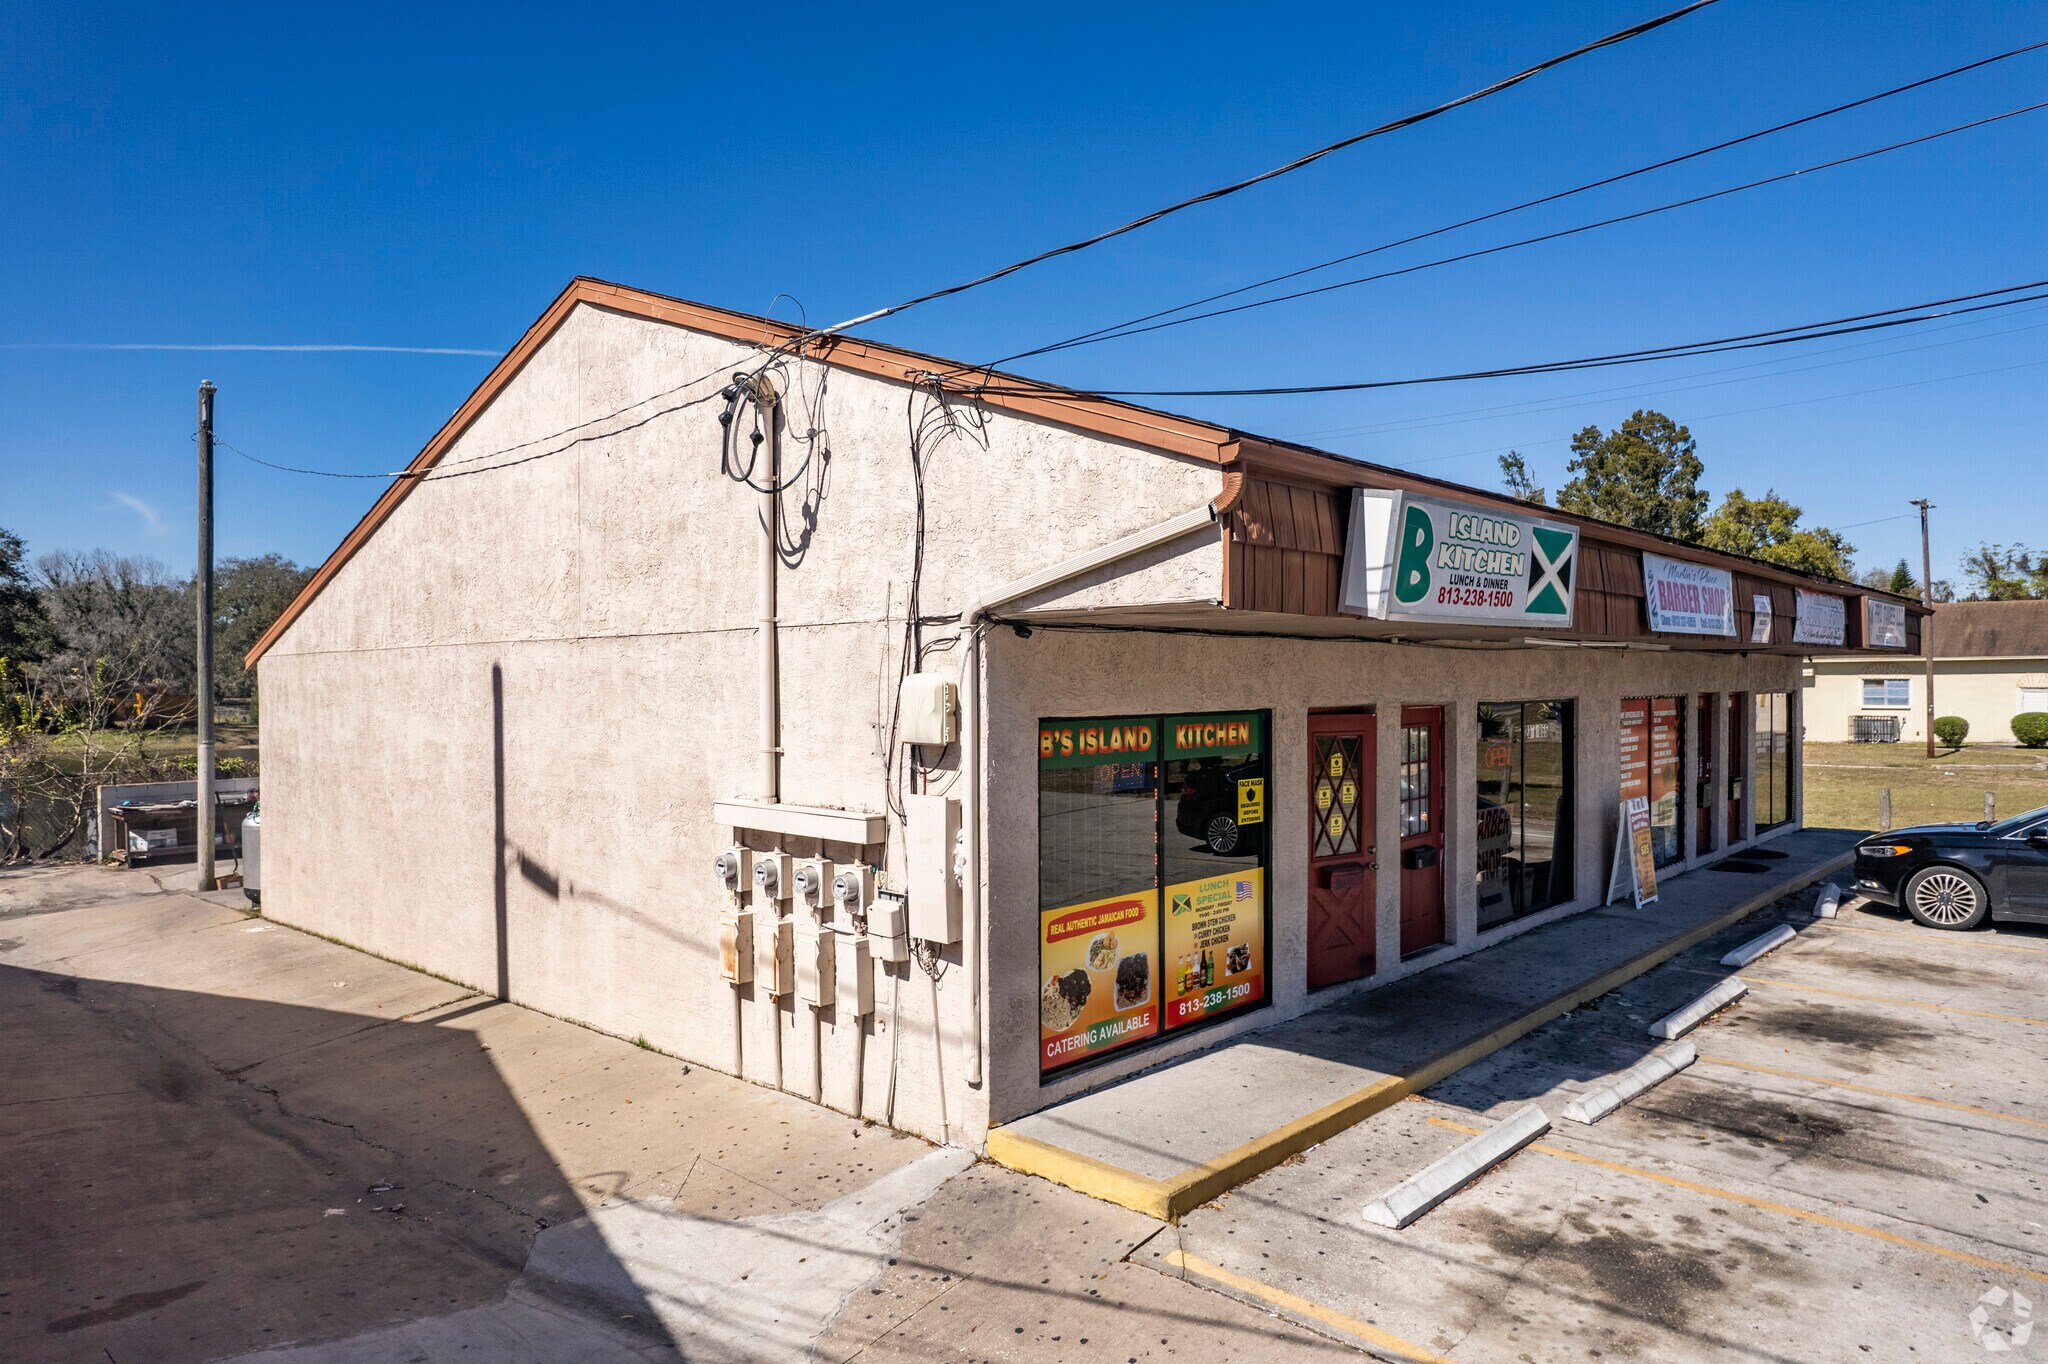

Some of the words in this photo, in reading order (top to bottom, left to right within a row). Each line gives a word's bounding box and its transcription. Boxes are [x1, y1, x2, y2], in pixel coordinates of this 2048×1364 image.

[1449, 512, 1521, 548] ISLAND
[1395, 504, 1434, 603] B
[1437, 542, 1526, 577] KITCHEN
[1450, 573, 1475, 587] LUNCH
[1476, 576, 1482, 588] &
[1483, 577, 1509, 590] DINNER
[1664, 561, 1696, 581] Martin's
[1437, 586, 1513, 608] 813-238-1500
[1658, 579, 1701, 613] BARBER
[1702, 585, 1726, 616] SHOP
[1079, 726, 1153, 755] ISLAND
[1175, 721, 1250, 750] KITCHEN
[1485, 746, 1511, 768] OPEN
[1100, 763, 1140, 781] OPEN
[1199, 879, 1229, 893] LUNCH
[1195, 904, 1215, 912] MONDAY
[1217, 900, 1233, 908] FRIDAY
[1196, 890, 1232, 905] SPECIAL
[1050, 922, 1066, 935] REAL
[1066, 915, 1098, 932] AUTHENTIC
[1098, 910, 1125, 924] JAMAICAN
[1125, 907, 1139, 919] FOOD
[1192, 920, 1207, 931] BROWN
[1219, 913, 1236, 924] CHICKEN
[1198, 928, 1212, 940] CURRY
[1212, 924, 1231, 936] CHICKEN
[1200, 938, 1211, 949] JERK
[1211, 934, 1229, 946] CHICKEN
[1179, 982, 1251, 1016] 813-238-1500
[1047, 1030, 1098, 1057] CATERING
[1099, 1013, 1150, 1041] AVAILABLE
